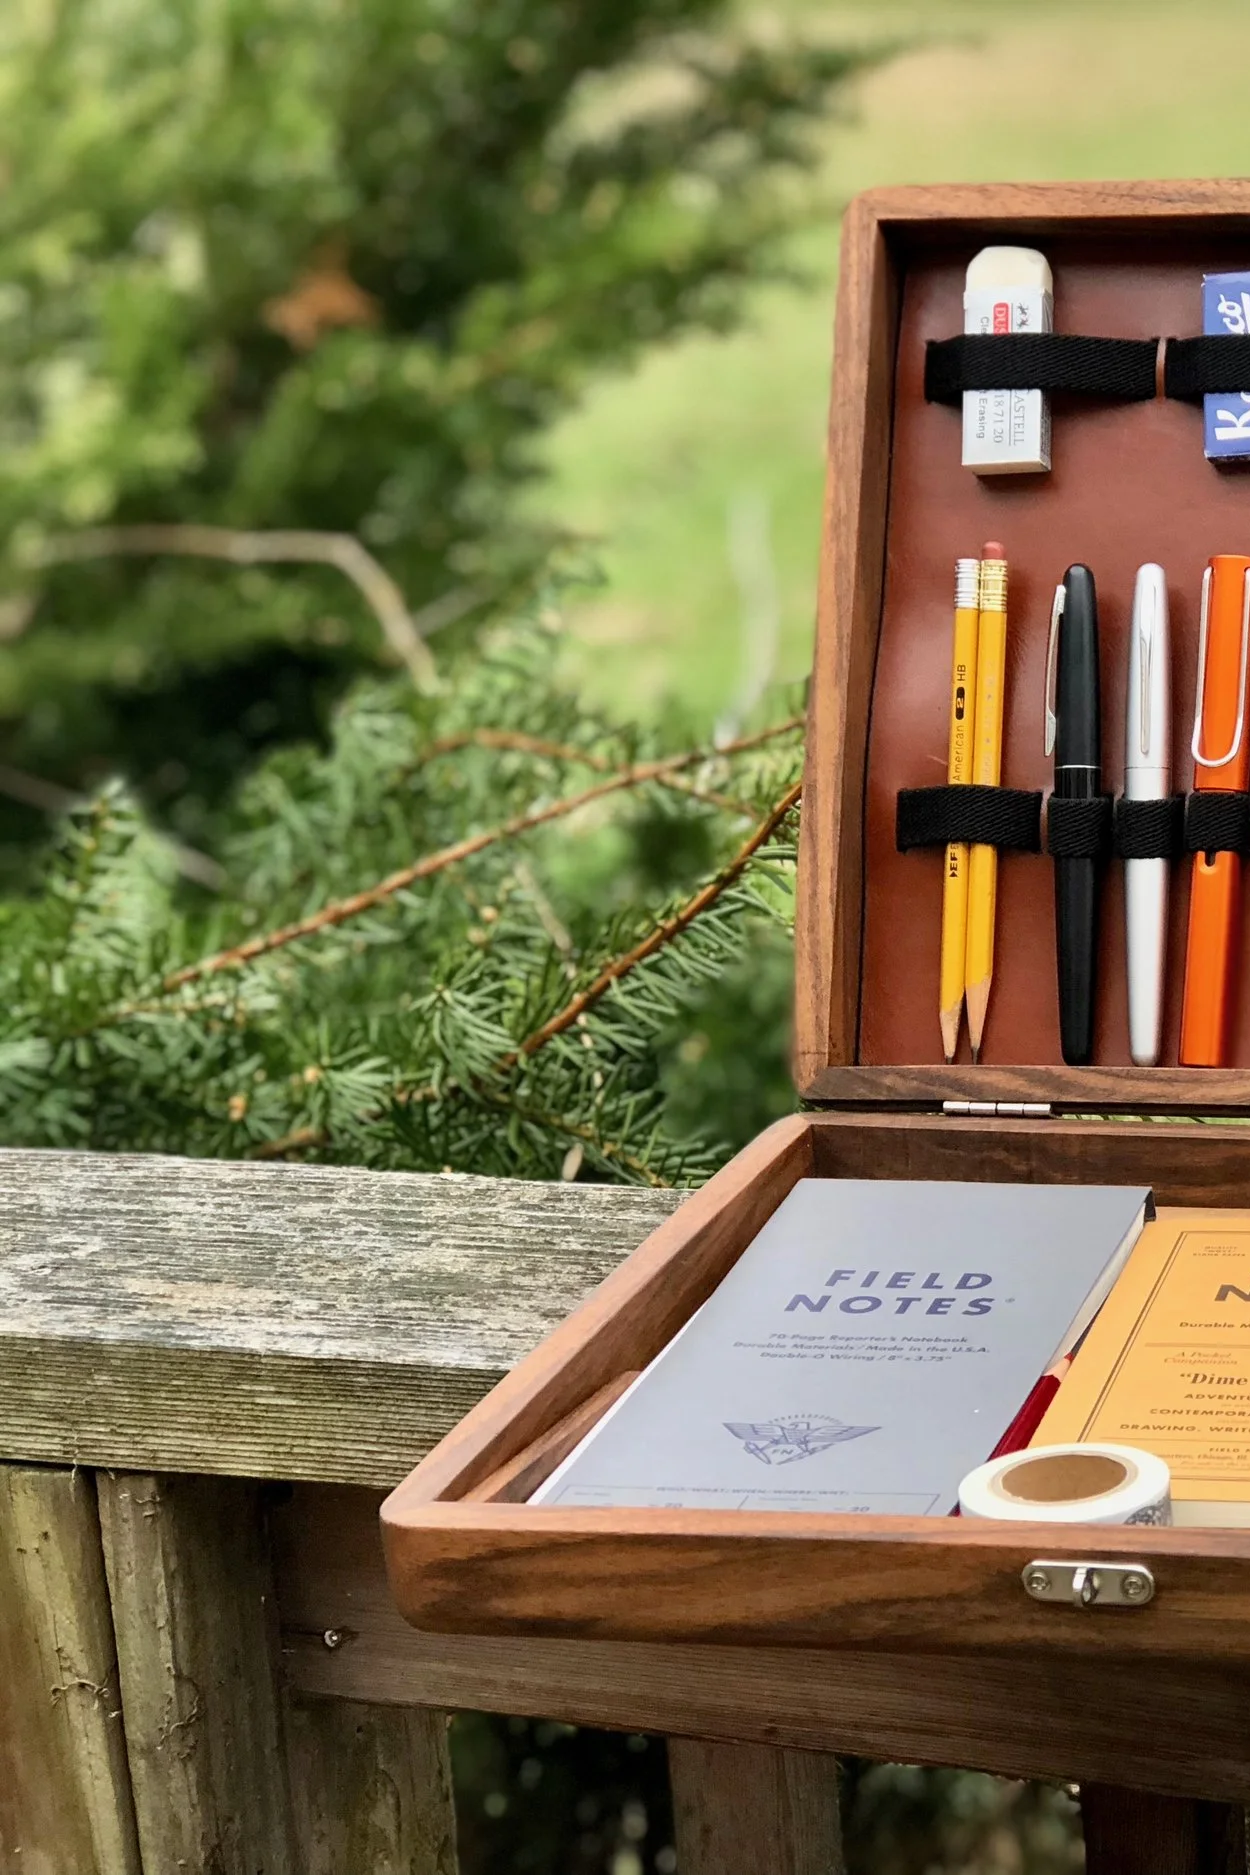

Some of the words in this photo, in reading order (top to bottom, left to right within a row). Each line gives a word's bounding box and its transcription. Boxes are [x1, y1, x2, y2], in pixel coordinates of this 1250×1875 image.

[976, 397, 988, 439] Erasing
[993, 411, 1005, 424] 71
[992, 428, 1004, 444] 20
[957, 664, 966, 682] HB
[956, 697, 964, 709] 2
[953, 725, 965, 782] American
[824, 1269, 993, 1290] FIELD
